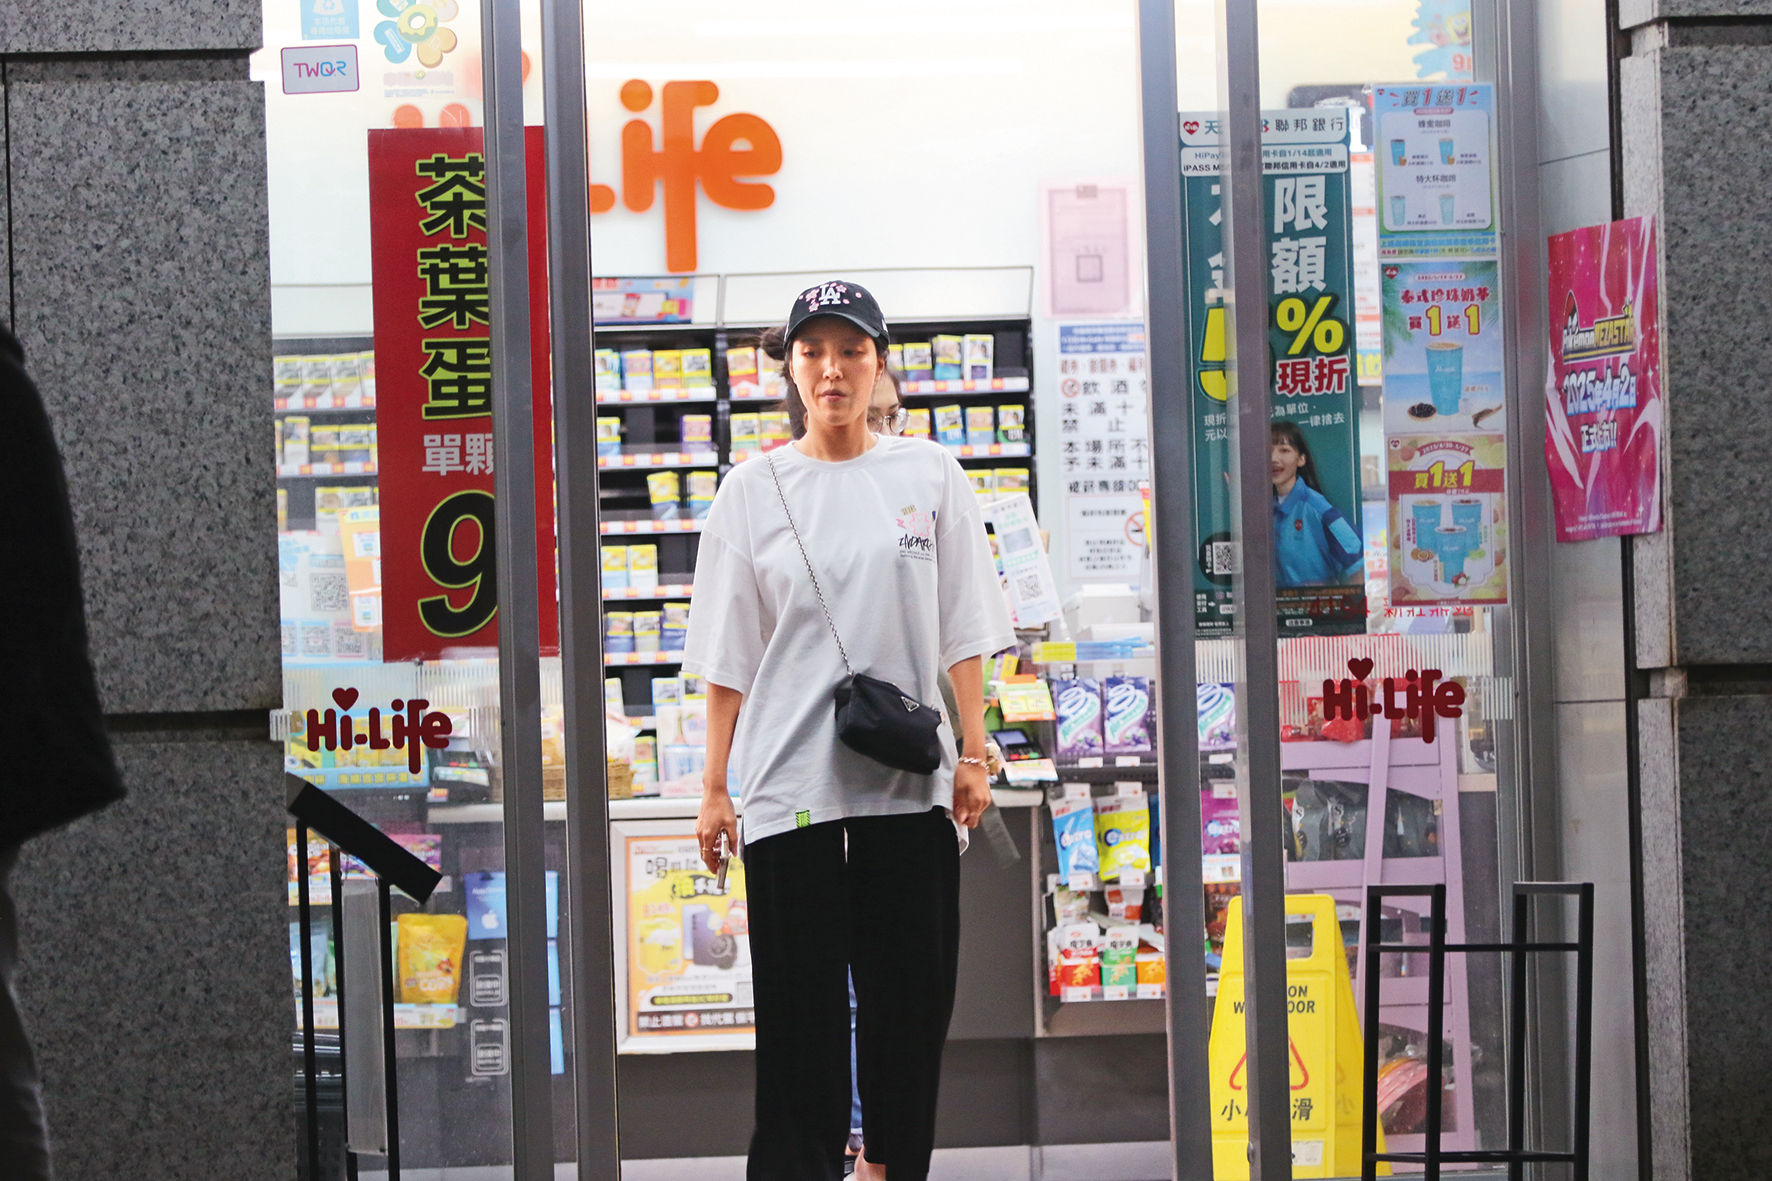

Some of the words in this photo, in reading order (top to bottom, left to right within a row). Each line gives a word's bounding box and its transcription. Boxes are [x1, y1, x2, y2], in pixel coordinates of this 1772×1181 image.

[293, 61, 347, 78] TWQR
[1275, 117, 1344, 133] 聯邦銀行
[1183, 163, 1212, 172] iPASS
[1262, 160, 1346, 171] 聯邦信用卡自4/2適用
[819, 284, 840, 305] LA
[1409, 304, 1480, 337] 買1送1
[1276, 357, 1350, 397] 現折
[1062, 402, 1146, 416] 未滿十
[1414, 460, 1475, 489] 買1送1
[417, 490, 498, 638] 9
[1288, 1001, 1316, 1014] OOR
